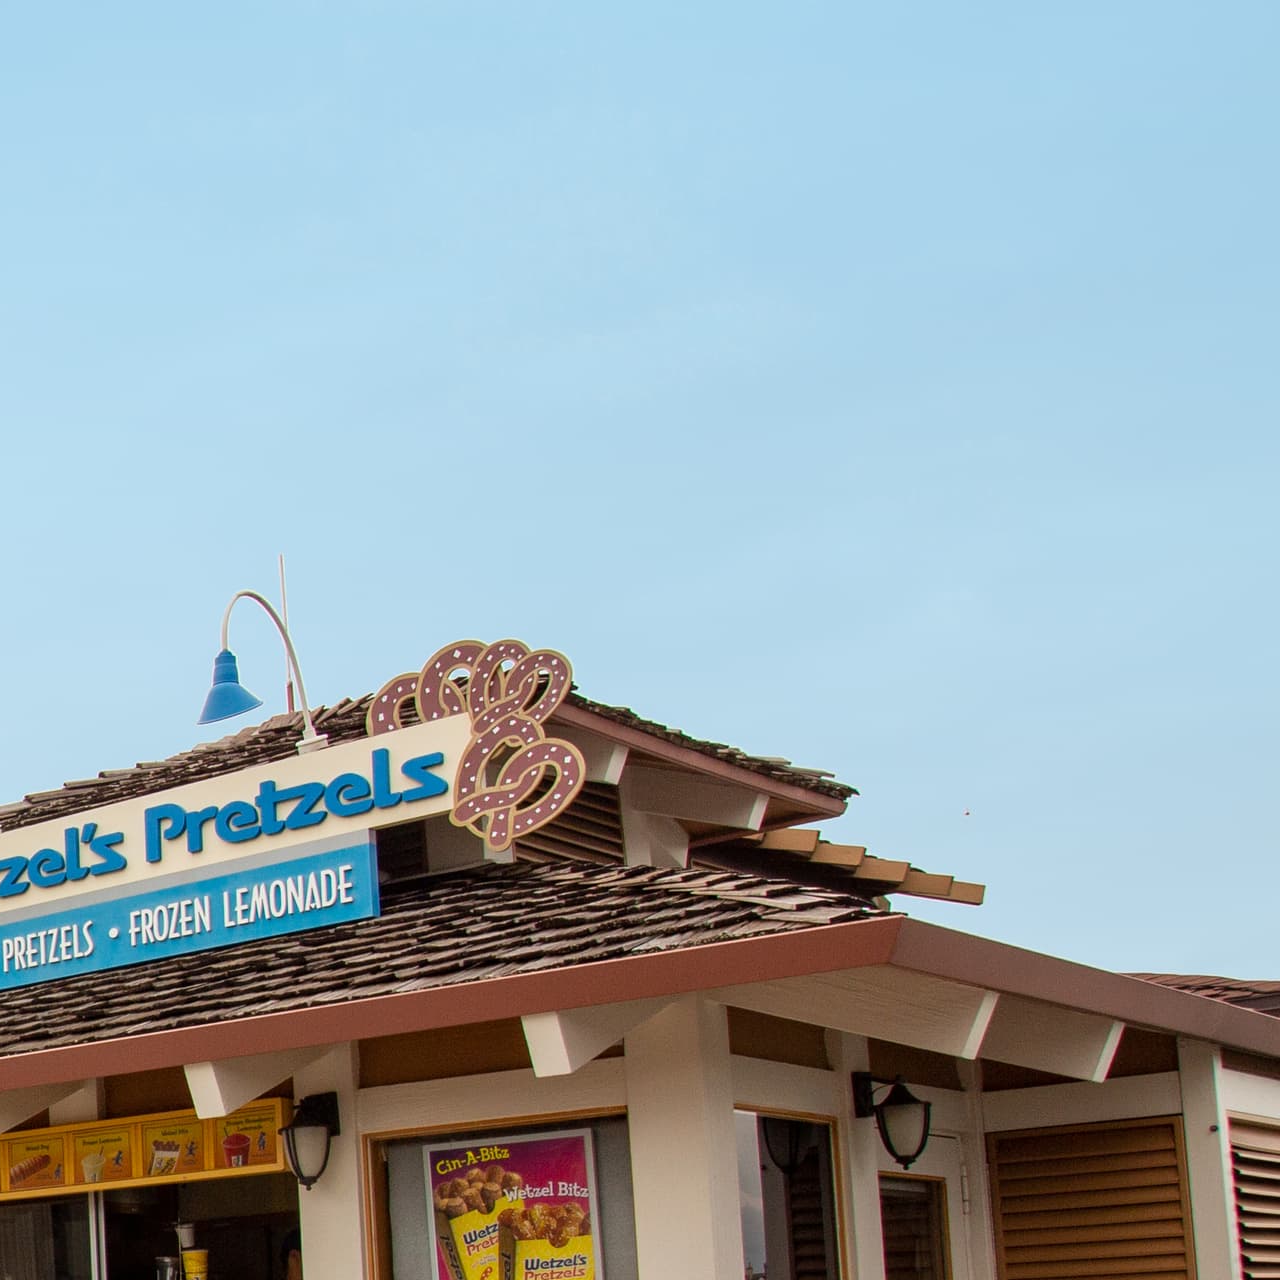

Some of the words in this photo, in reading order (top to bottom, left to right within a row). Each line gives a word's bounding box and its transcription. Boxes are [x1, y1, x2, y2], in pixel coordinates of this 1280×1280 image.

[144, 747, 449, 863] Pretzels
[3, 919, 94, 972] PRETZELS
[128, 895, 212, 946] FROZEN
[223, 864, 354, 929] LEMONADE
[435, 1146, 510, 1175] Cin-A-Bitz
[504, 1181, 554, 1202] Wetzel
[557, 1181, 590, 1199] Bitz
[524, 1253, 588, 1271] Wetzel's
